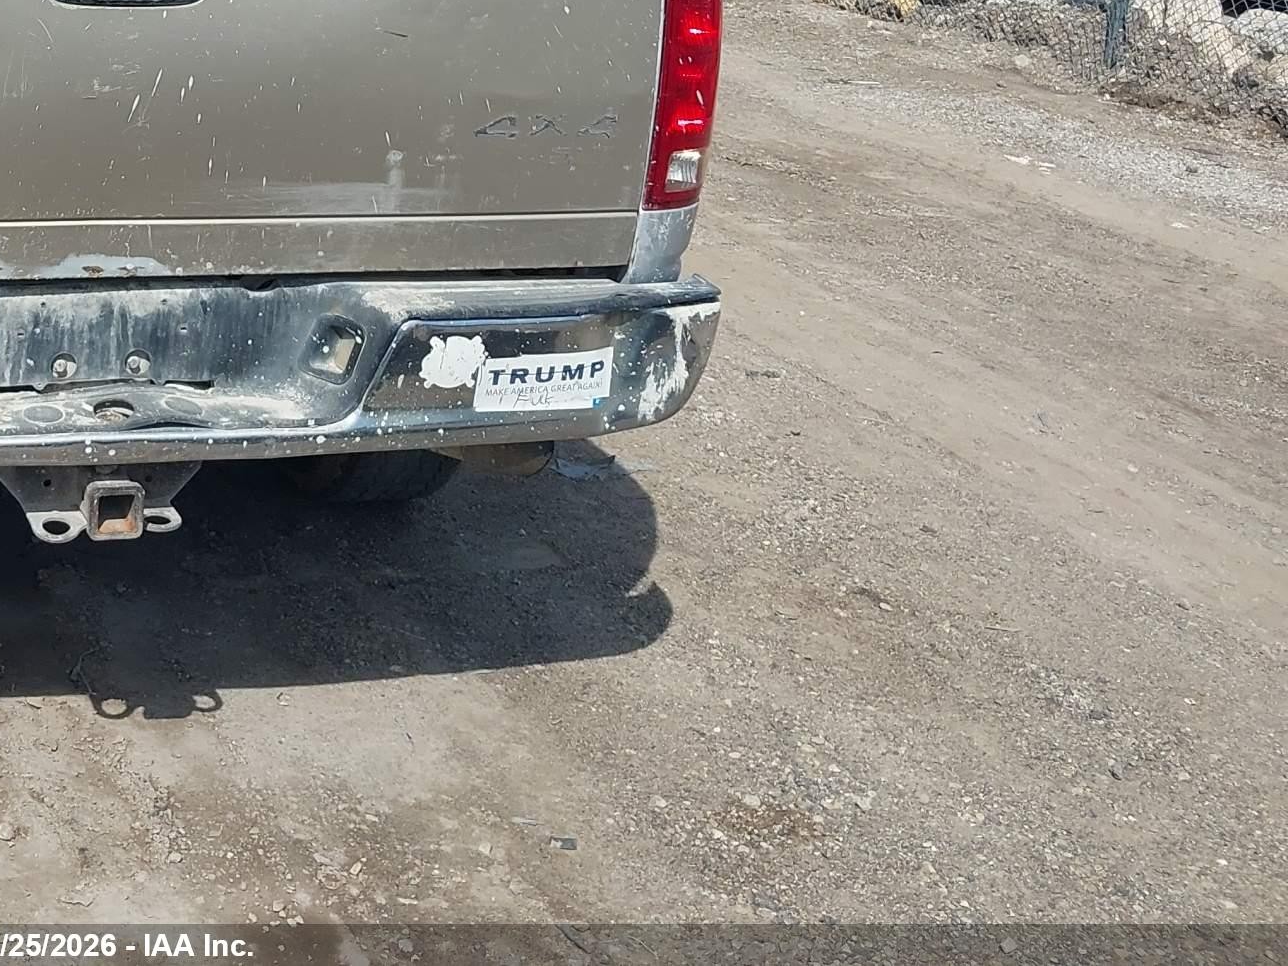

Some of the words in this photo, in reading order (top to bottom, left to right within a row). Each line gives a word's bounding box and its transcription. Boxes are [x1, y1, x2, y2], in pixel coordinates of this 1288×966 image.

[489, 360, 605, 385] TRUMP
[486, 387, 511, 397] MAKE
[512, 384, 548, 395] AMERICA
[551, 382, 577, 393] GREAT
